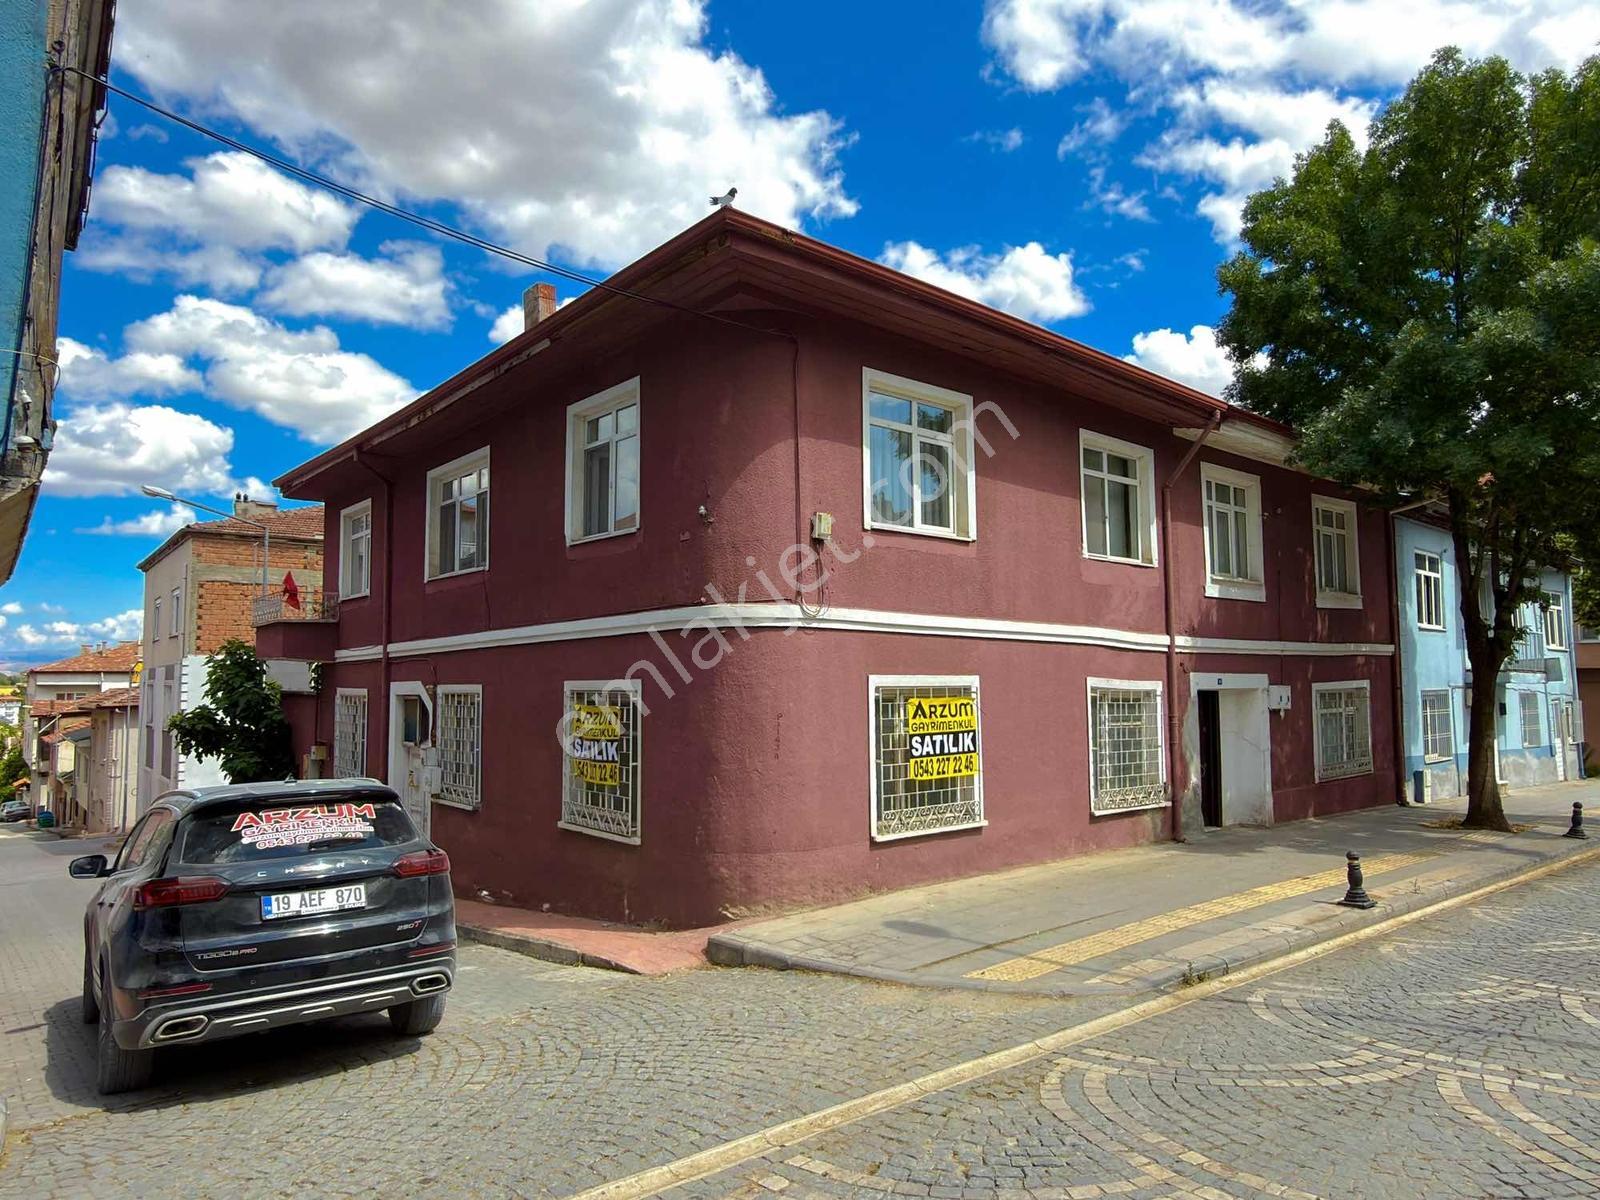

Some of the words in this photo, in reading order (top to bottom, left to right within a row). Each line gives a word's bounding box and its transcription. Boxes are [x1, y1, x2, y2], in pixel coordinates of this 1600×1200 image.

[912, 701, 974, 719] ARZUM
[911, 732, 975, 756] SATILIK
[914, 759, 934, 777] 0543
[936, 758, 950, 775] 227
[953, 757, 962, 774] 22
[964, 756, 973, 772] 46
[230, 803, 376, 831] ARZUM
[257, 859, 369, 877] CHRY
[274, 895, 291, 911] 19
[300, 891, 326, 908] AEF
[336, 887, 362, 904] 870
